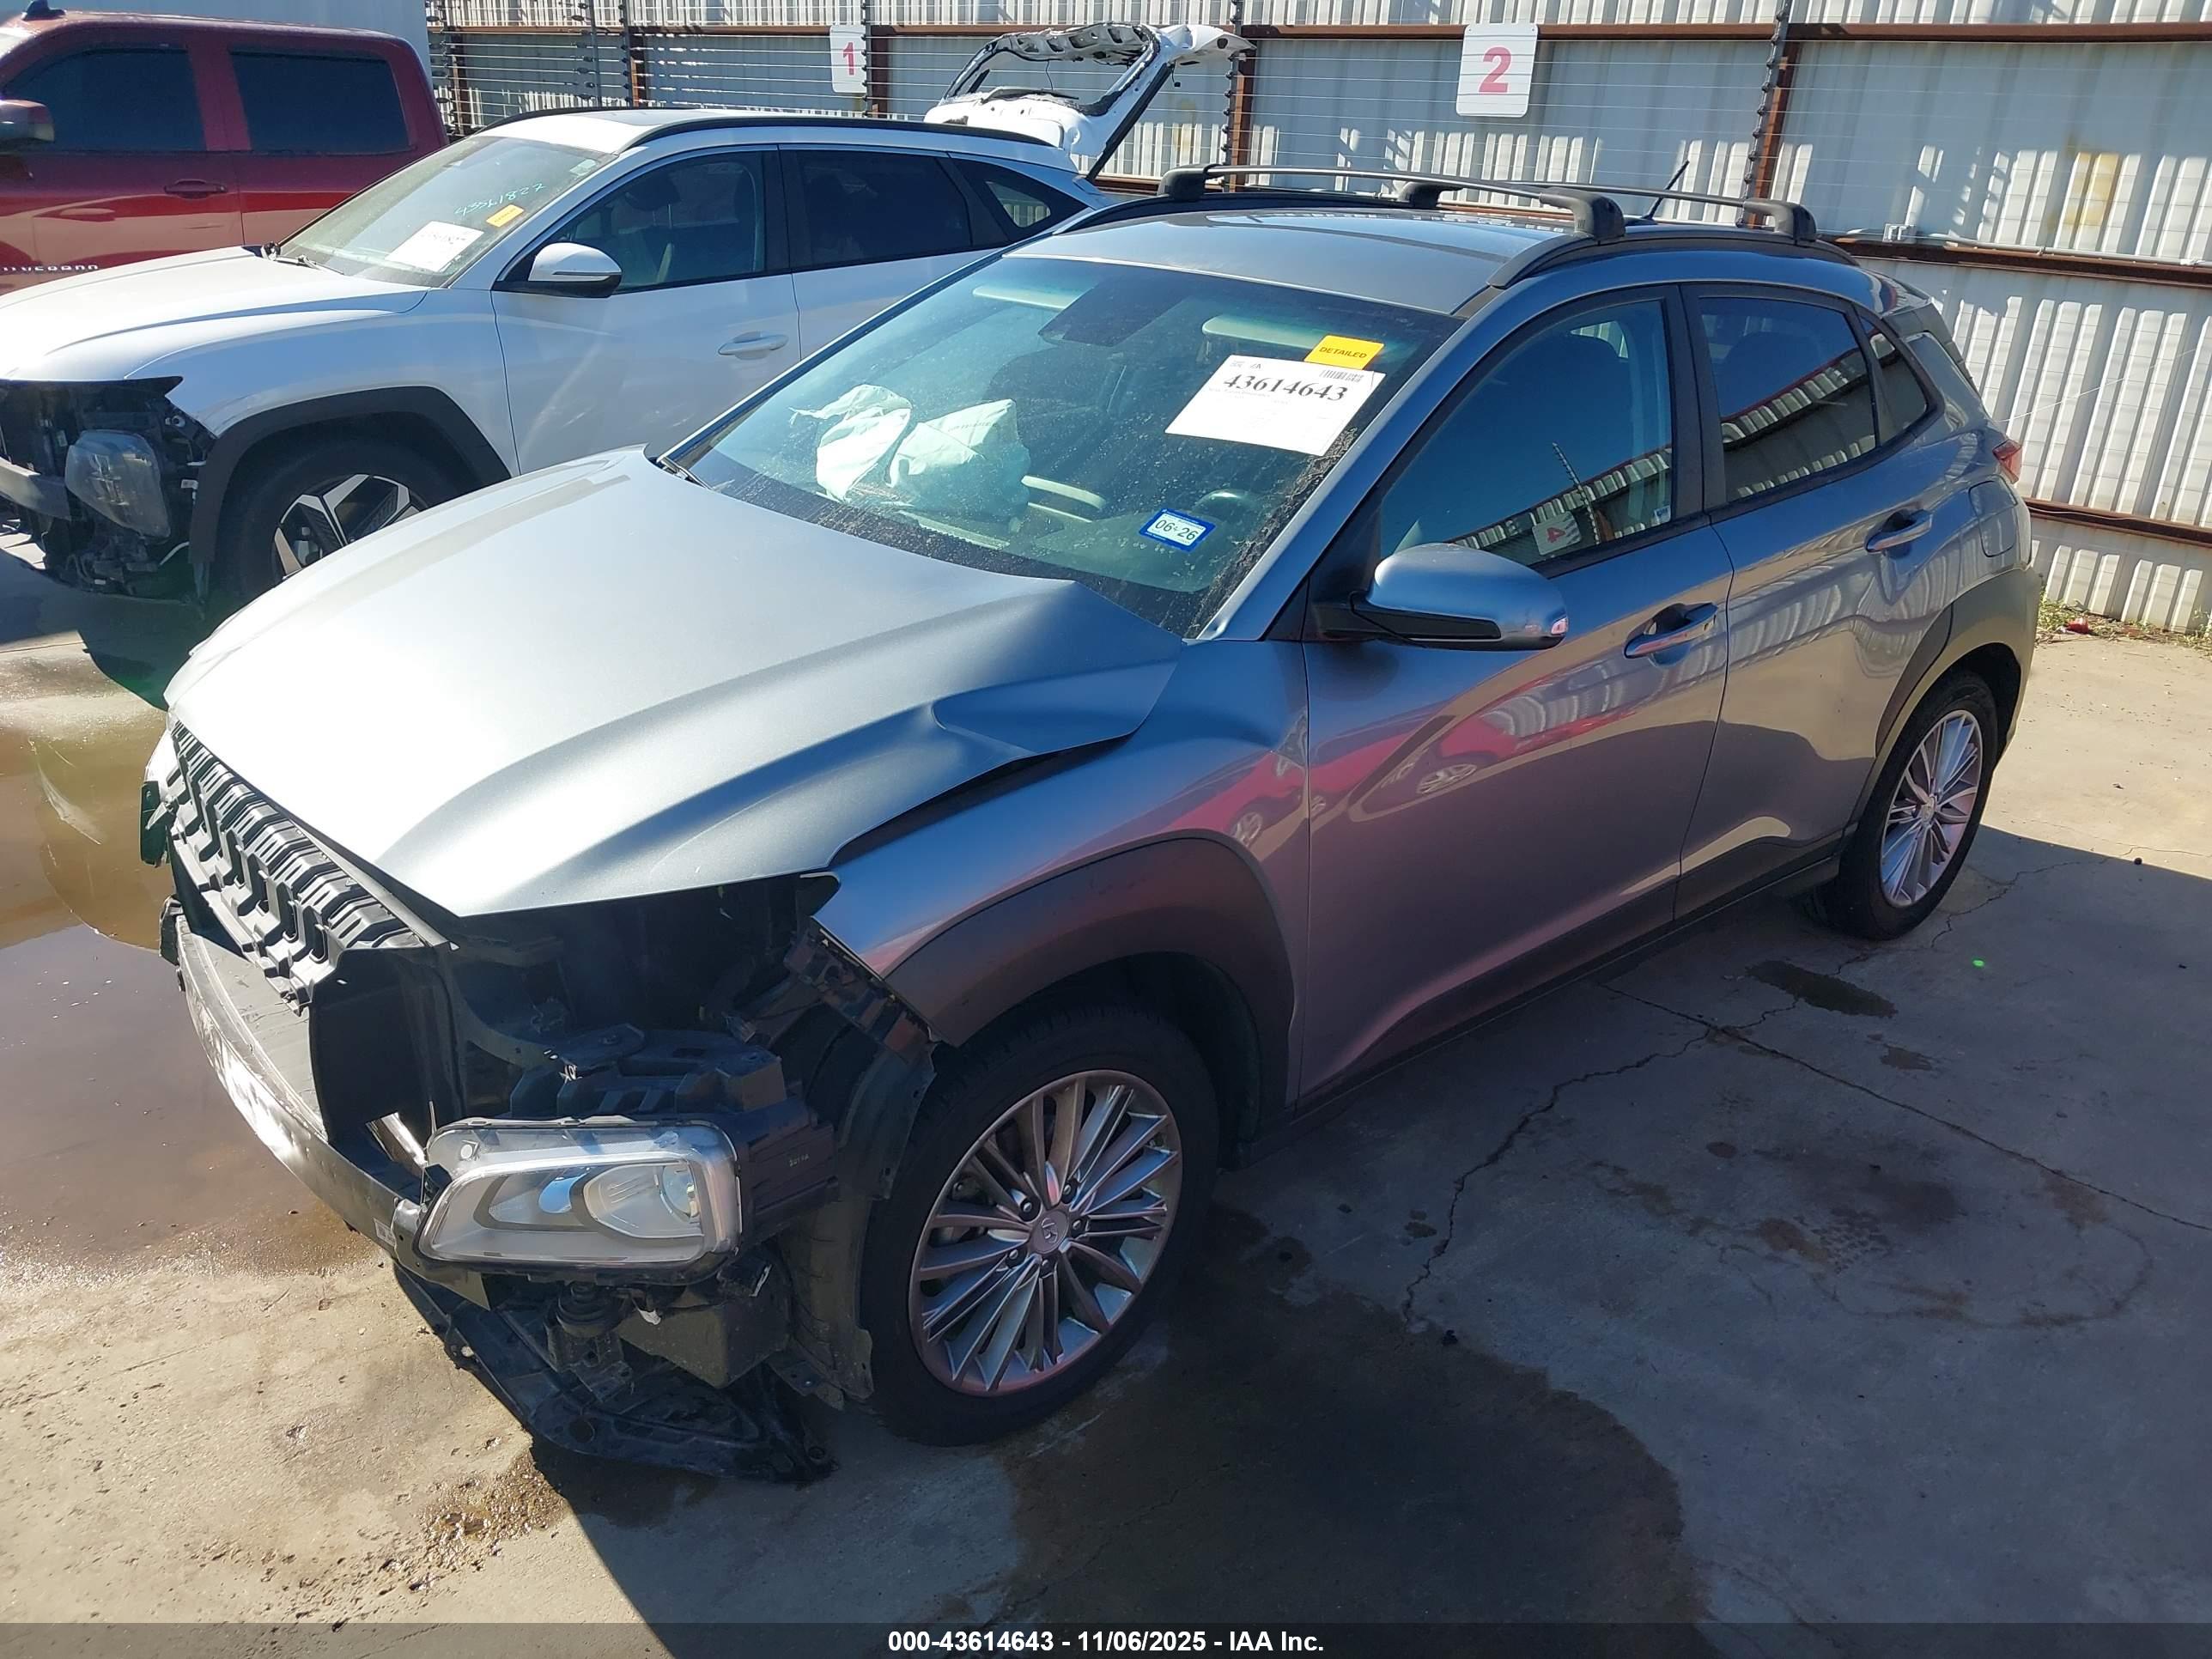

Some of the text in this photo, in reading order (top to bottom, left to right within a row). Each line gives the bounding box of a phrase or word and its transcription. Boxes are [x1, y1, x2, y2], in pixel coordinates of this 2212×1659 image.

[842, 41, 854, 76] 1
[1479, 46, 1512, 94] 2
[1318, 346, 1367, 360] DETAILED
[1224, 374, 1348, 401] 43614643
